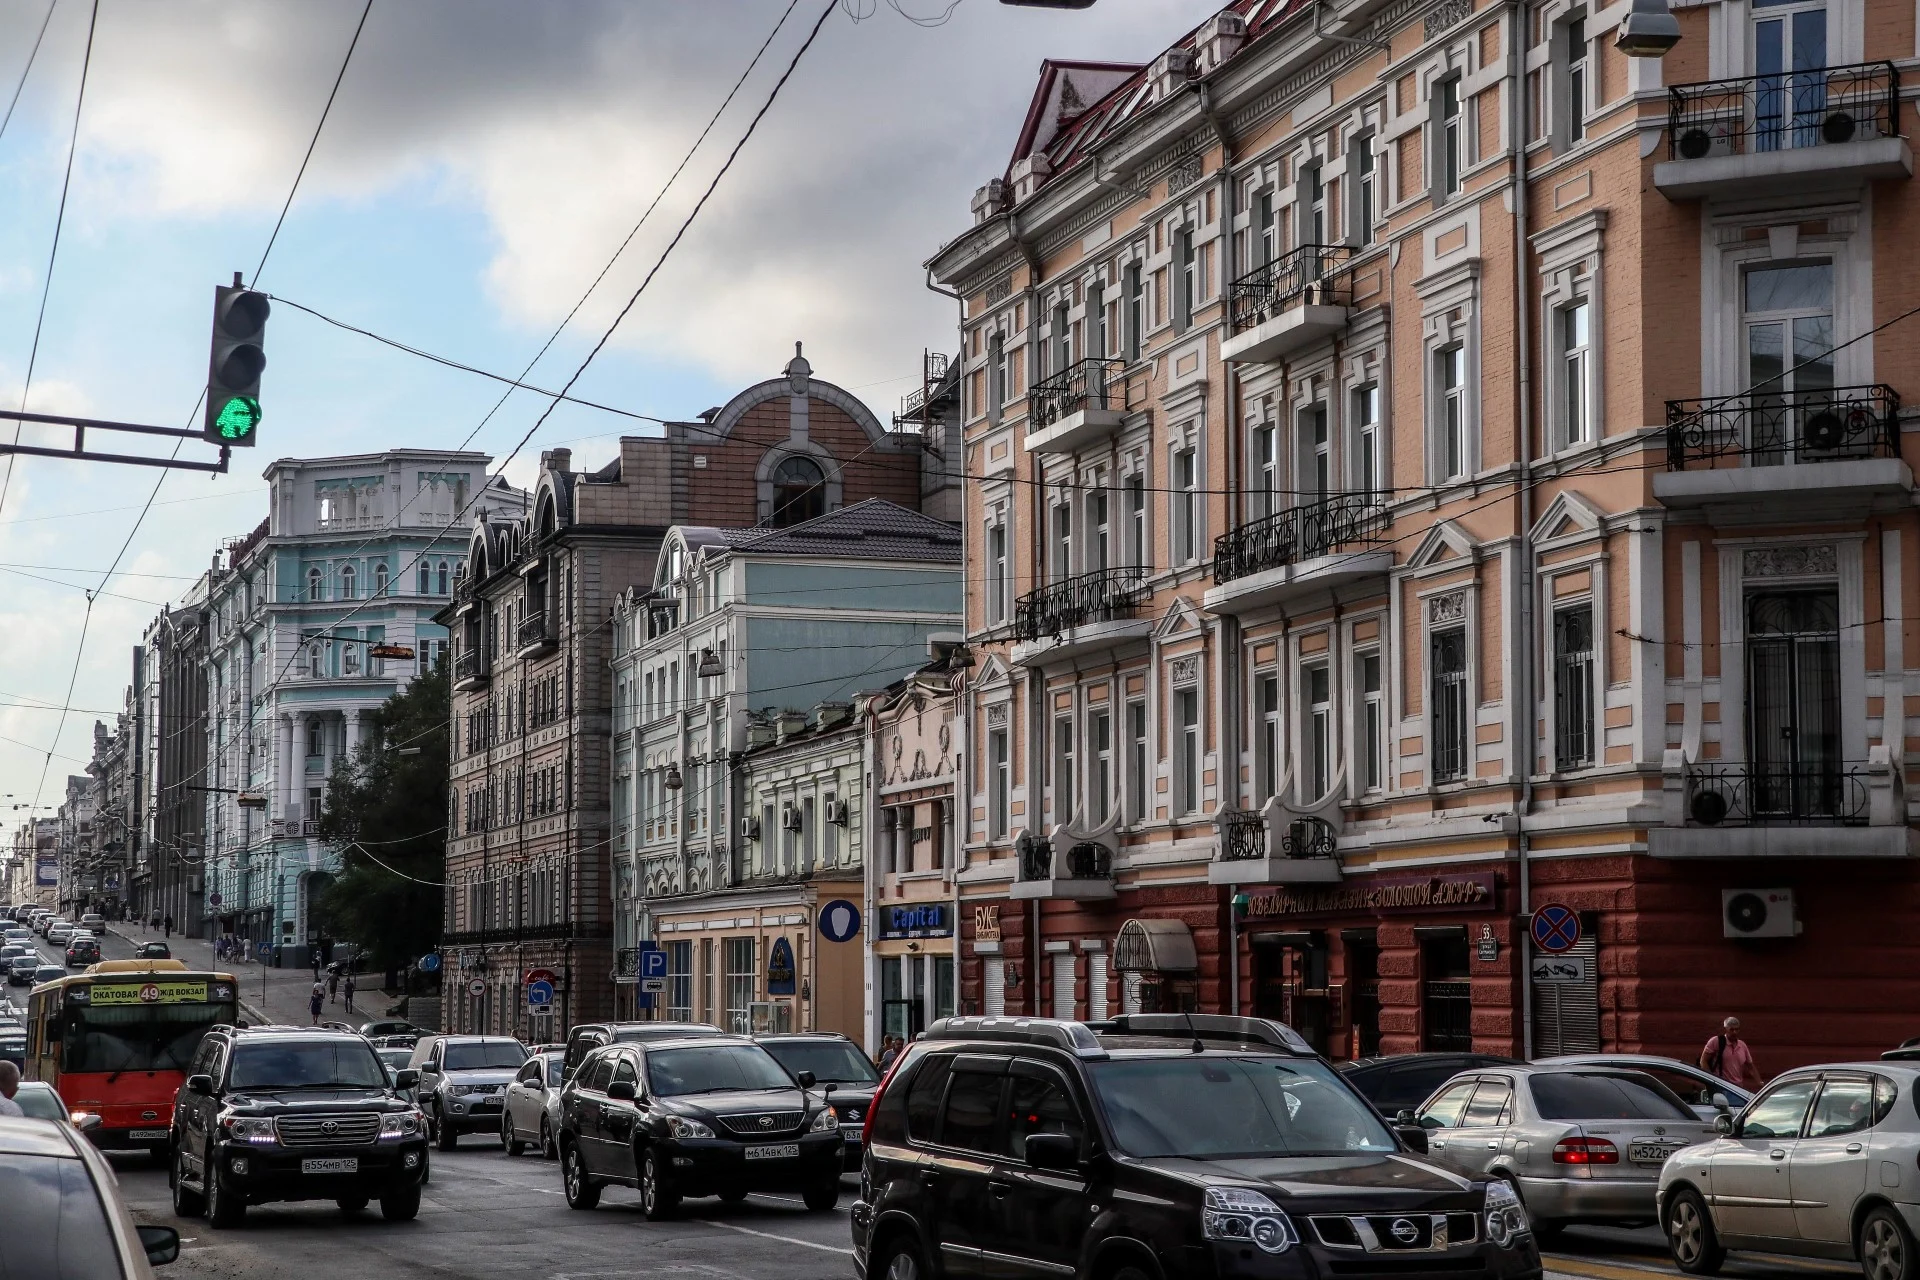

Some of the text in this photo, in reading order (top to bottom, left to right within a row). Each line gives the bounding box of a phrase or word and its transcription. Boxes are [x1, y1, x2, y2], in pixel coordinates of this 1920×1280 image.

[892, 905, 941, 930] Capital
[1482, 927, 1490, 940] 55
[649, 954, 663, 975] P
[93, 990, 138, 999] ОКАТОВАЯ
[140, 988, 159, 1000] 49
[175, 988, 205, 996] ВОКЗАЛ
